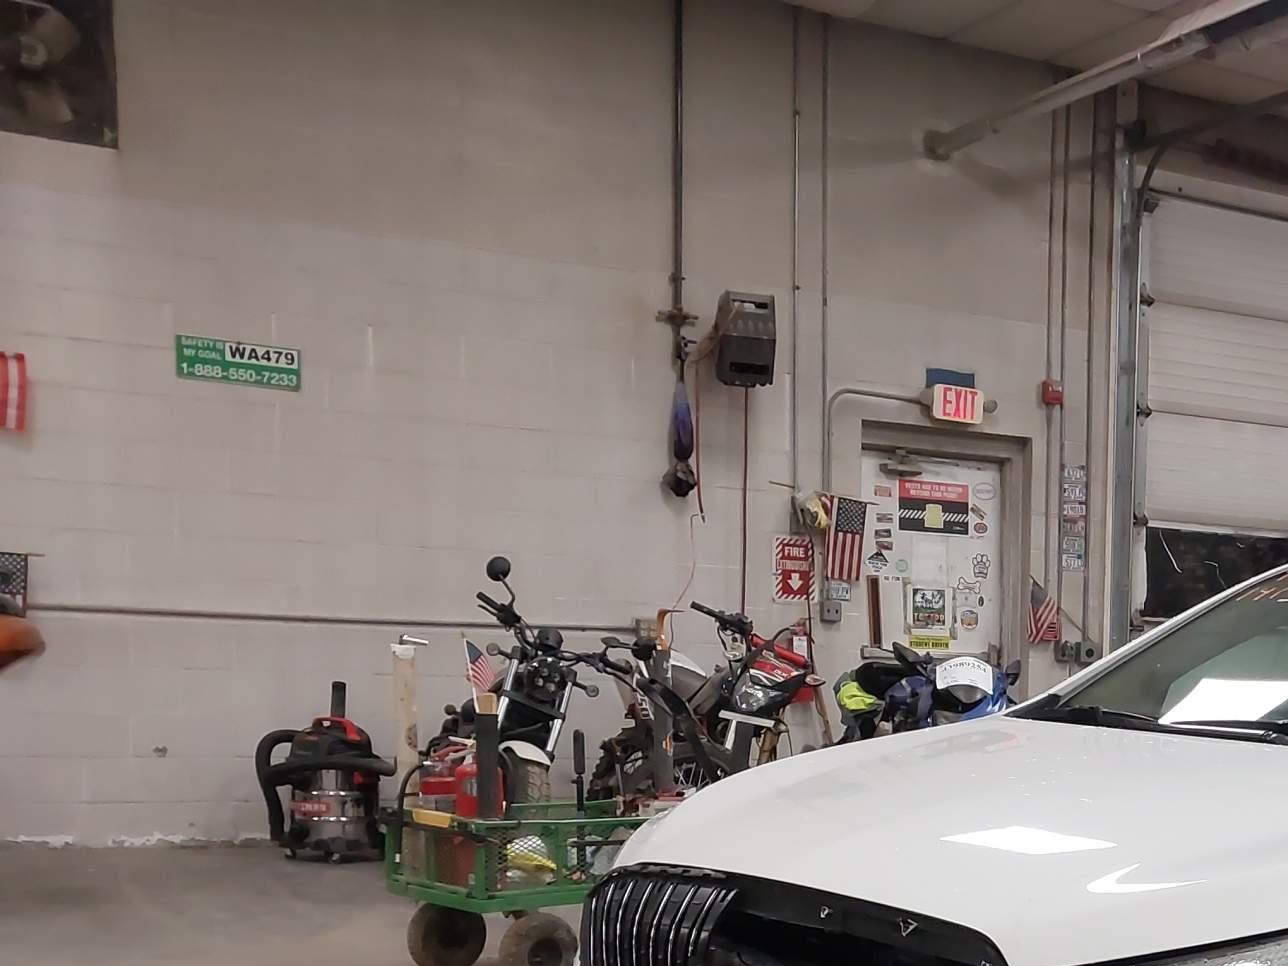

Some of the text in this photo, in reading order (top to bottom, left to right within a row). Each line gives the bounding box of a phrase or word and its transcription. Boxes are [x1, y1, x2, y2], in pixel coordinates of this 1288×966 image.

[181, 336, 214, 349] SAFETY
[183, 347, 223, 360] MY GOAL
[228, 344, 295, 366] WA479
[181, 362, 297, 387] 1-888-550-7233
[942, 387, 978, 420] EXIT
[784, 546, 806, 558] FIRE
